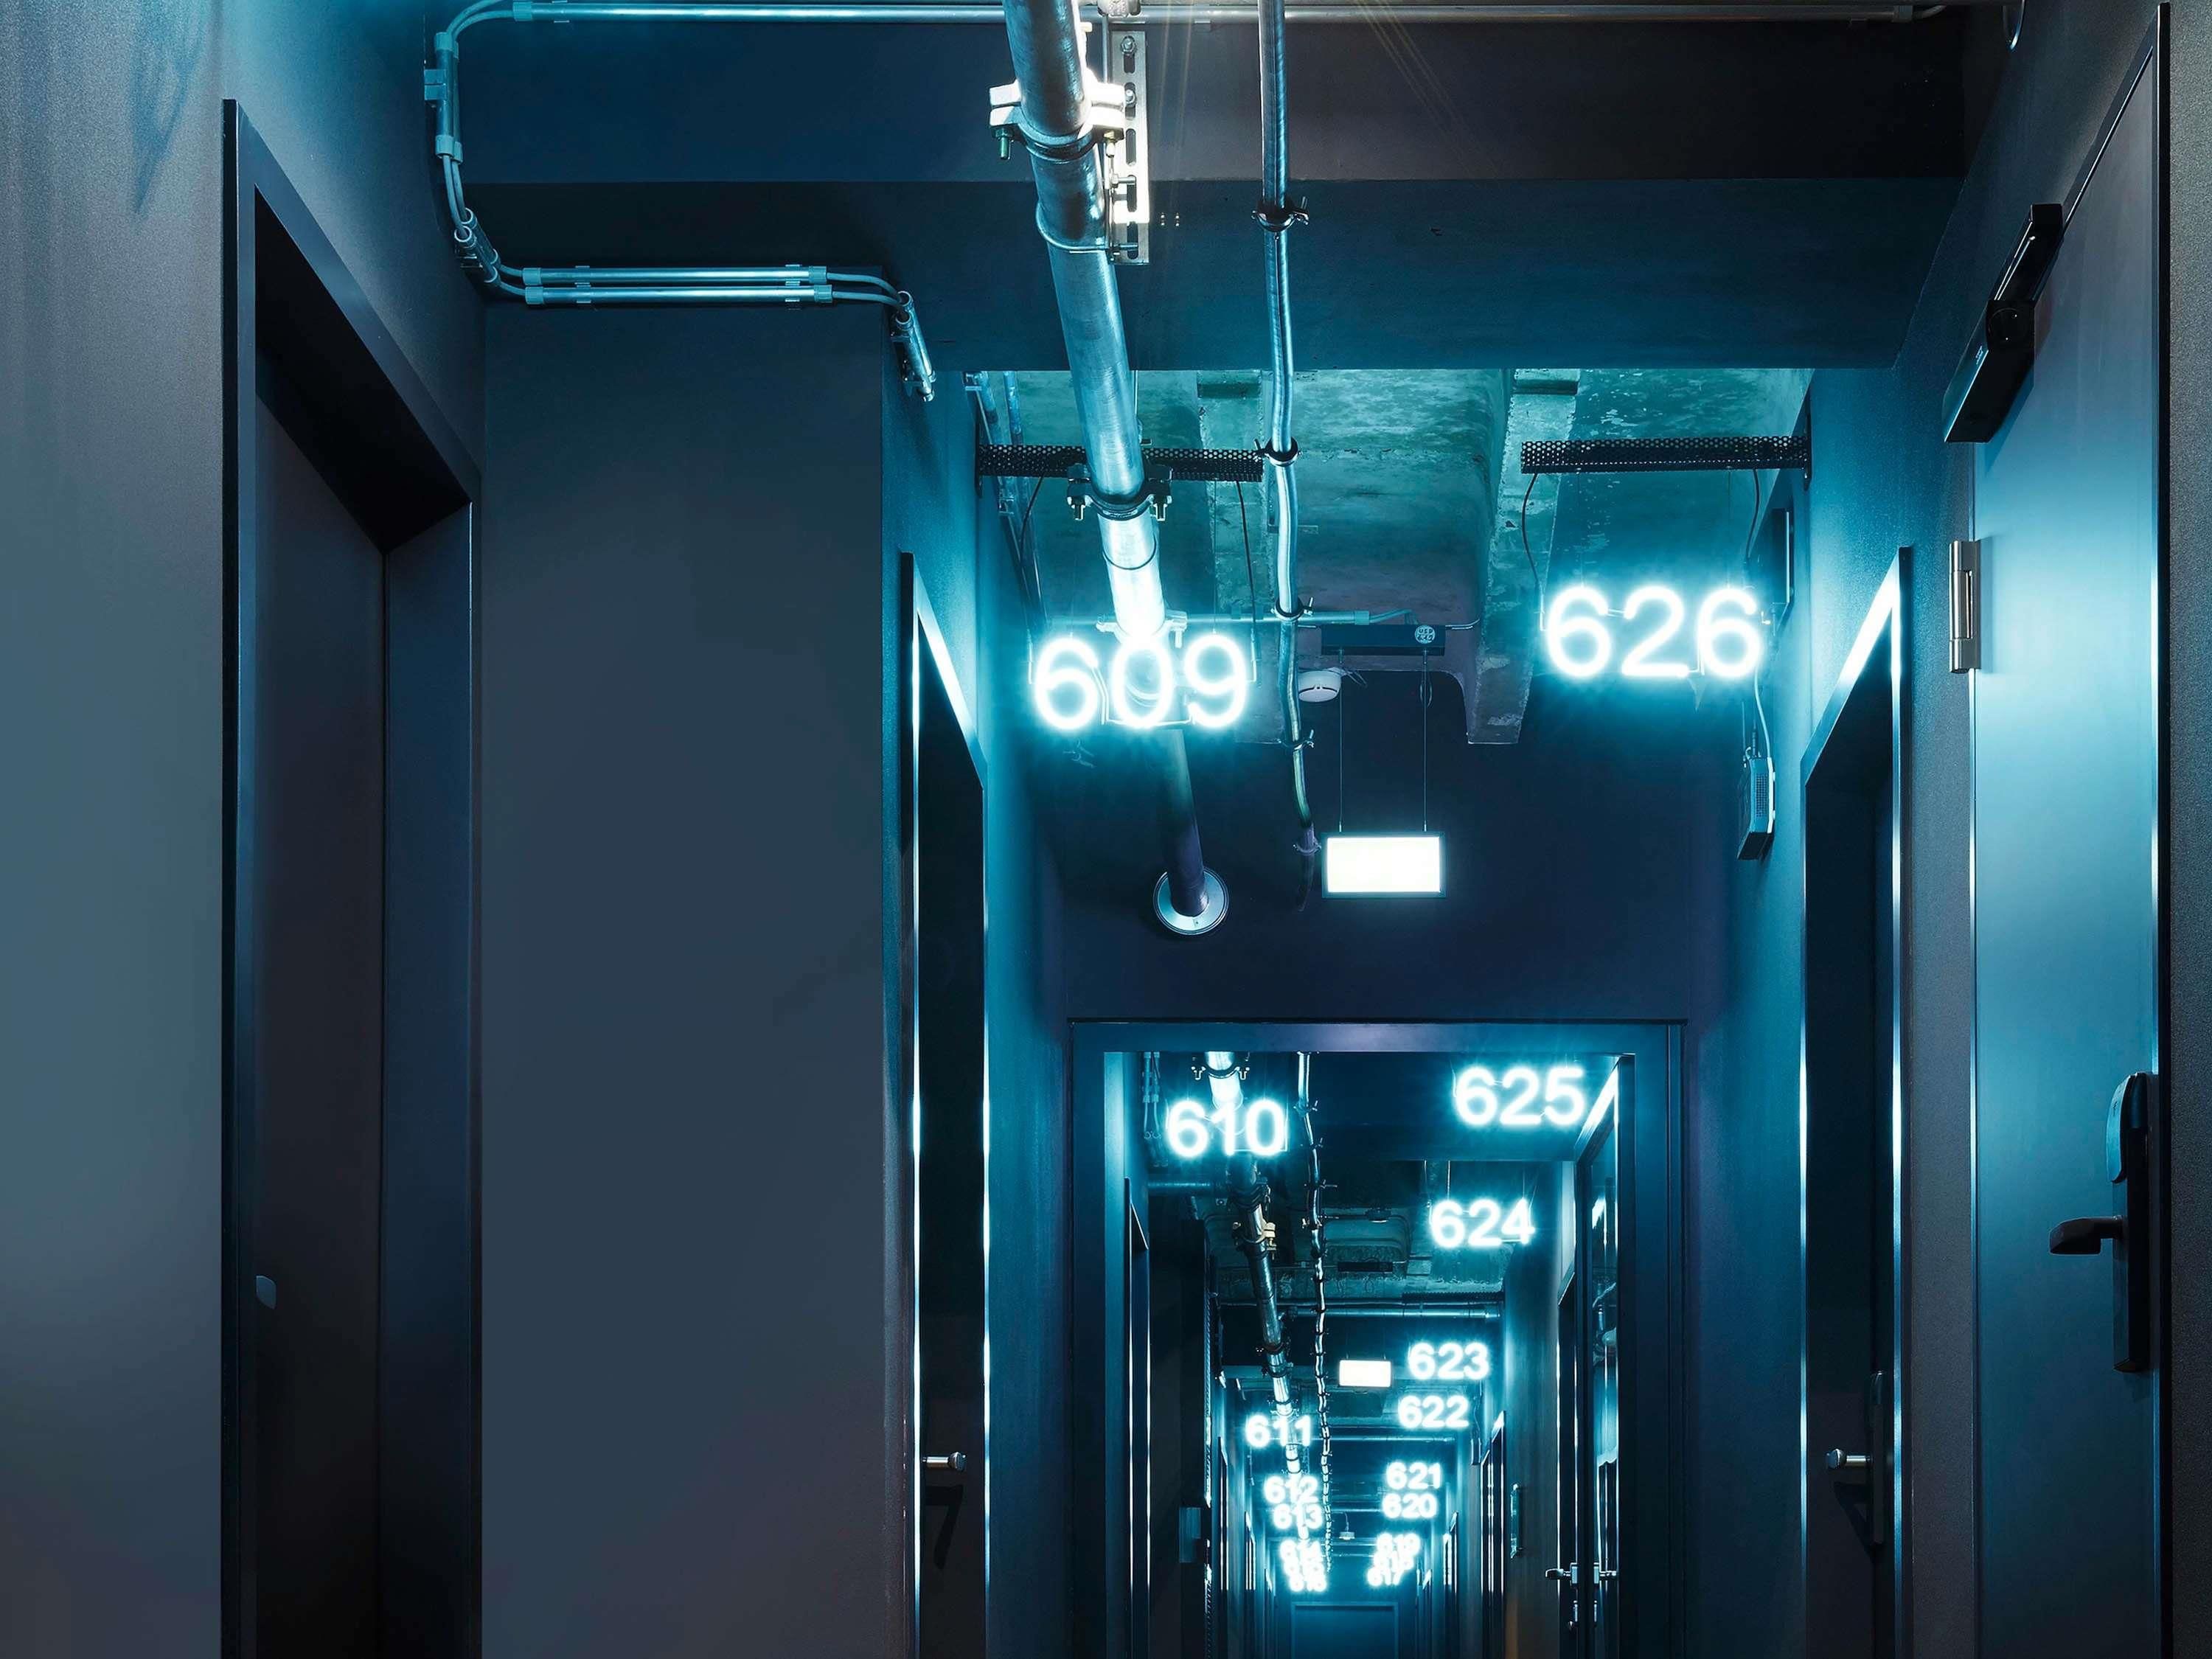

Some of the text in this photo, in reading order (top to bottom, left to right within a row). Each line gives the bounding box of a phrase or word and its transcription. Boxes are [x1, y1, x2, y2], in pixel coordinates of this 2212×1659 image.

[1545, 584, 1764, 680] 626
[1032, 635, 1250, 731] 609
[1453, 1065, 1586, 1128] 625
[1166, 1099, 1286, 1158] 610
[1429, 1198, 1535, 1248] 624
[1408, 1342, 1489, 1380] 623
[1397, 1395, 1469, 1428] 622
[1245, 1414, 1311, 1448] 611
[1264, 1475, 1318, 1505] 612
[1386, 1462, 1441, 1490] 621
[1273, 1504, 1323, 1529] 613
[1382, 1493, 1437, 1519] 620
